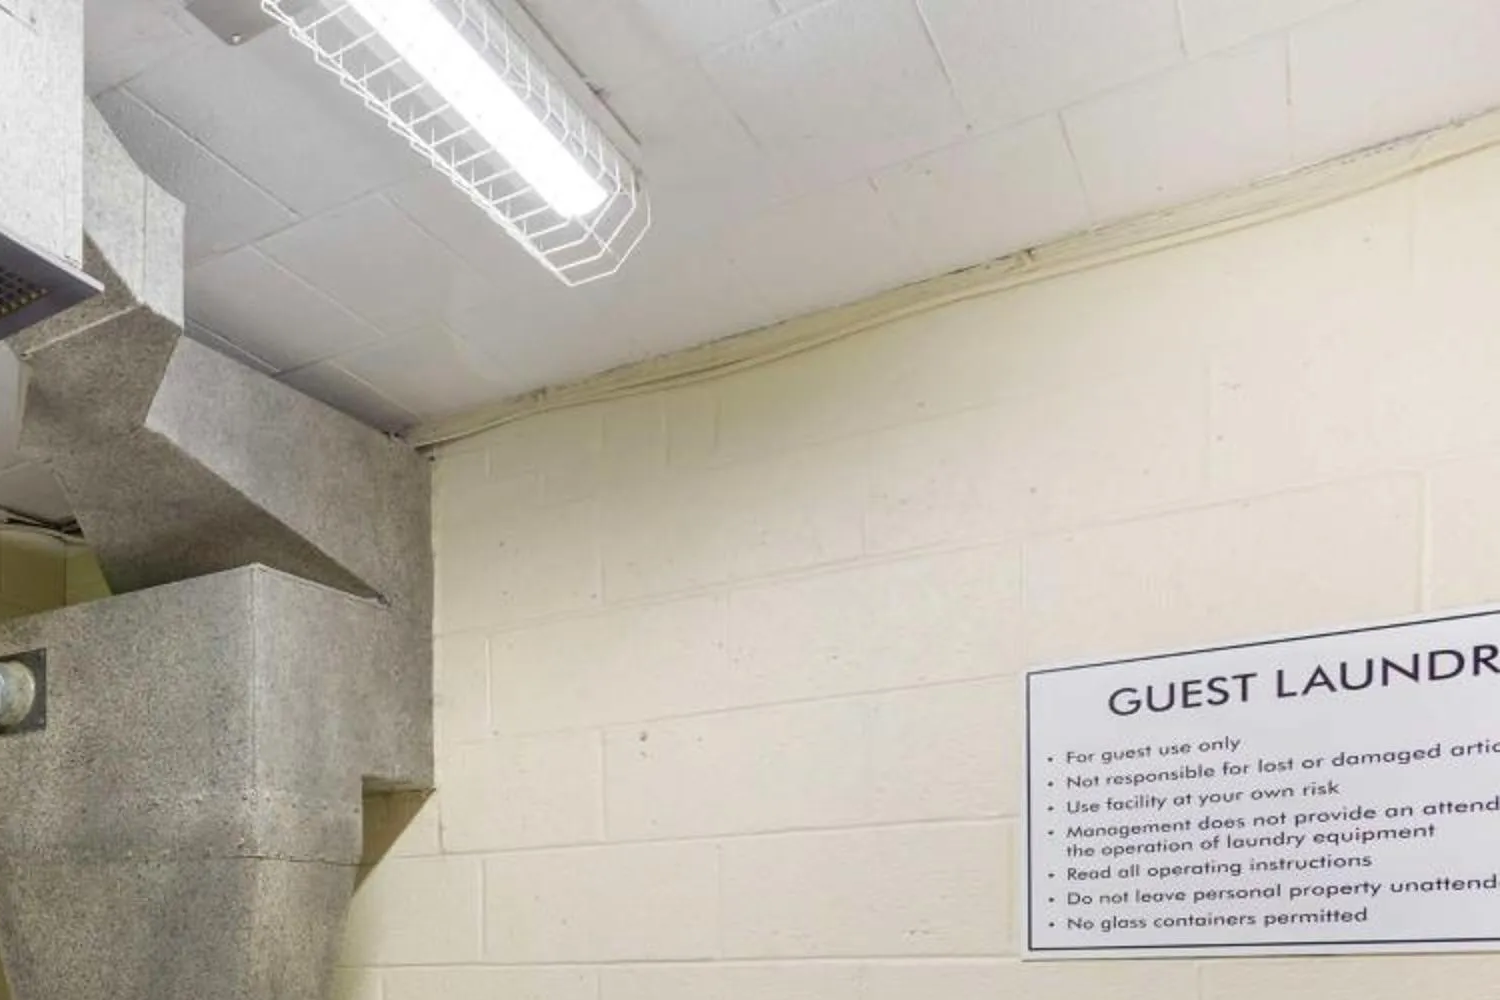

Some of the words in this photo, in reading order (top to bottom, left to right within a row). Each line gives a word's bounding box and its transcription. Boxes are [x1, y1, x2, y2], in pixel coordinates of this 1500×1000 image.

[1107, 672, 1258, 716] GUEST
[1276, 643, 1500, 699] LAUNDR
[1066, 750, 1095, 764] For
[1101, 745, 1152, 764] guest
[1159, 743, 1191, 757] use
[1199, 736, 1242, 753] only
[1066, 776, 1100, 790] Not
[1106, 763, 1216, 787] responsible
[1222, 761, 1250, 777] for
[1258, 757, 1294, 774] lost
[1301, 757, 1325, 770] or
[1331, 743, 1442, 766] damaged
[1066, 801, 1100, 814] Use
[1106, 794, 1169, 811] facility
[1173, 793, 1192, 807] at
[1199, 790, 1245, 807] your
[1251, 786, 1295, 801] own
[1302, 780, 1342, 797] risk
[1066, 819, 1192, 839] Management
[1198, 815, 1245, 831] does
[1253, 811, 1287, 827] not
[1295, 805, 1377, 827] provide
[1385, 804, 1414, 818] an
[1422, 795, 1500, 816] attend
[1066, 844, 1095, 858] the
[1101, 839, 1194, 859] operation
[1200, 834, 1221, 849] of
[1227, 831, 1307, 849] laundry
[1313, 823, 1437, 846] equipment
[1067, 865, 1112, 881] Read
[1117, 864, 1140, 879] all
[1147, 860, 1242, 880] operating
[1249, 853, 1373, 873] instructions
[1067, 891, 1093, 905] Do
[1100, 891, 1129, 905] not
[1135, 889, 1187, 904] leave
[1193, 883, 1282, 904] personal
[1289, 880, 1382, 902] property
[1390, 873, 1500, 894] unattend
[1067, 917, 1095, 931] No
[1101, 915, 1148, 933] glass
[1153, 912, 1257, 929] containers
[1263, 906, 1369, 928] permitted
